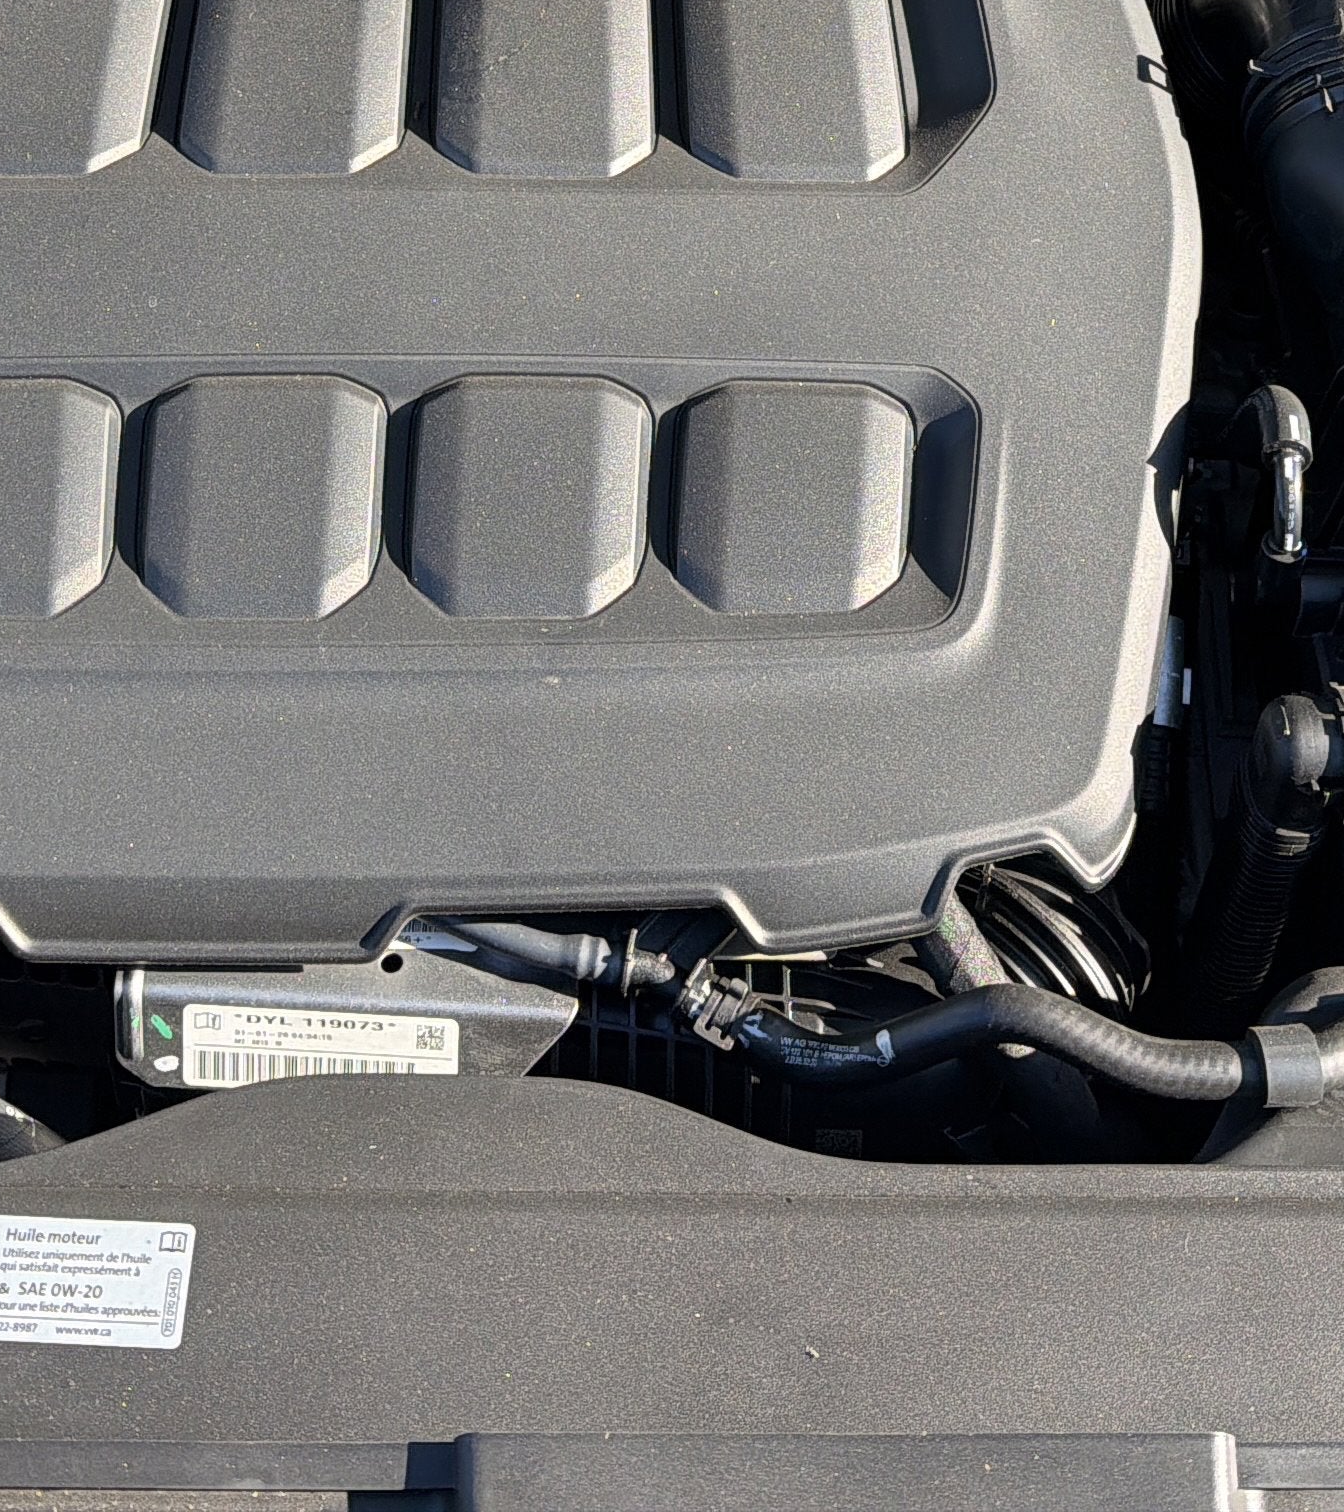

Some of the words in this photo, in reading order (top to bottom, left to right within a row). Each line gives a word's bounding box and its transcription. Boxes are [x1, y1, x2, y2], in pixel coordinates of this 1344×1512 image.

[5, 1228, 45, 1244] Huile
[47, 1231, 103, 1245] moteur
[2, 1247, 40, 1260] Utilisez
[42, 1249, 104, 1264] uniquement
[105, 1252, 119, 1264] de
[0, 1261, 17, 1274] qui
[18, 1262, 58, 1273] satisfait
[60, 1264, 133, 1277] expressément
[17, 1281, 48, 1297] SAE
[50, 1282, 104, 1299] 0W-20
[17, 1301, 38, 1312] une
[39, 1301, 60, 1313] liste
